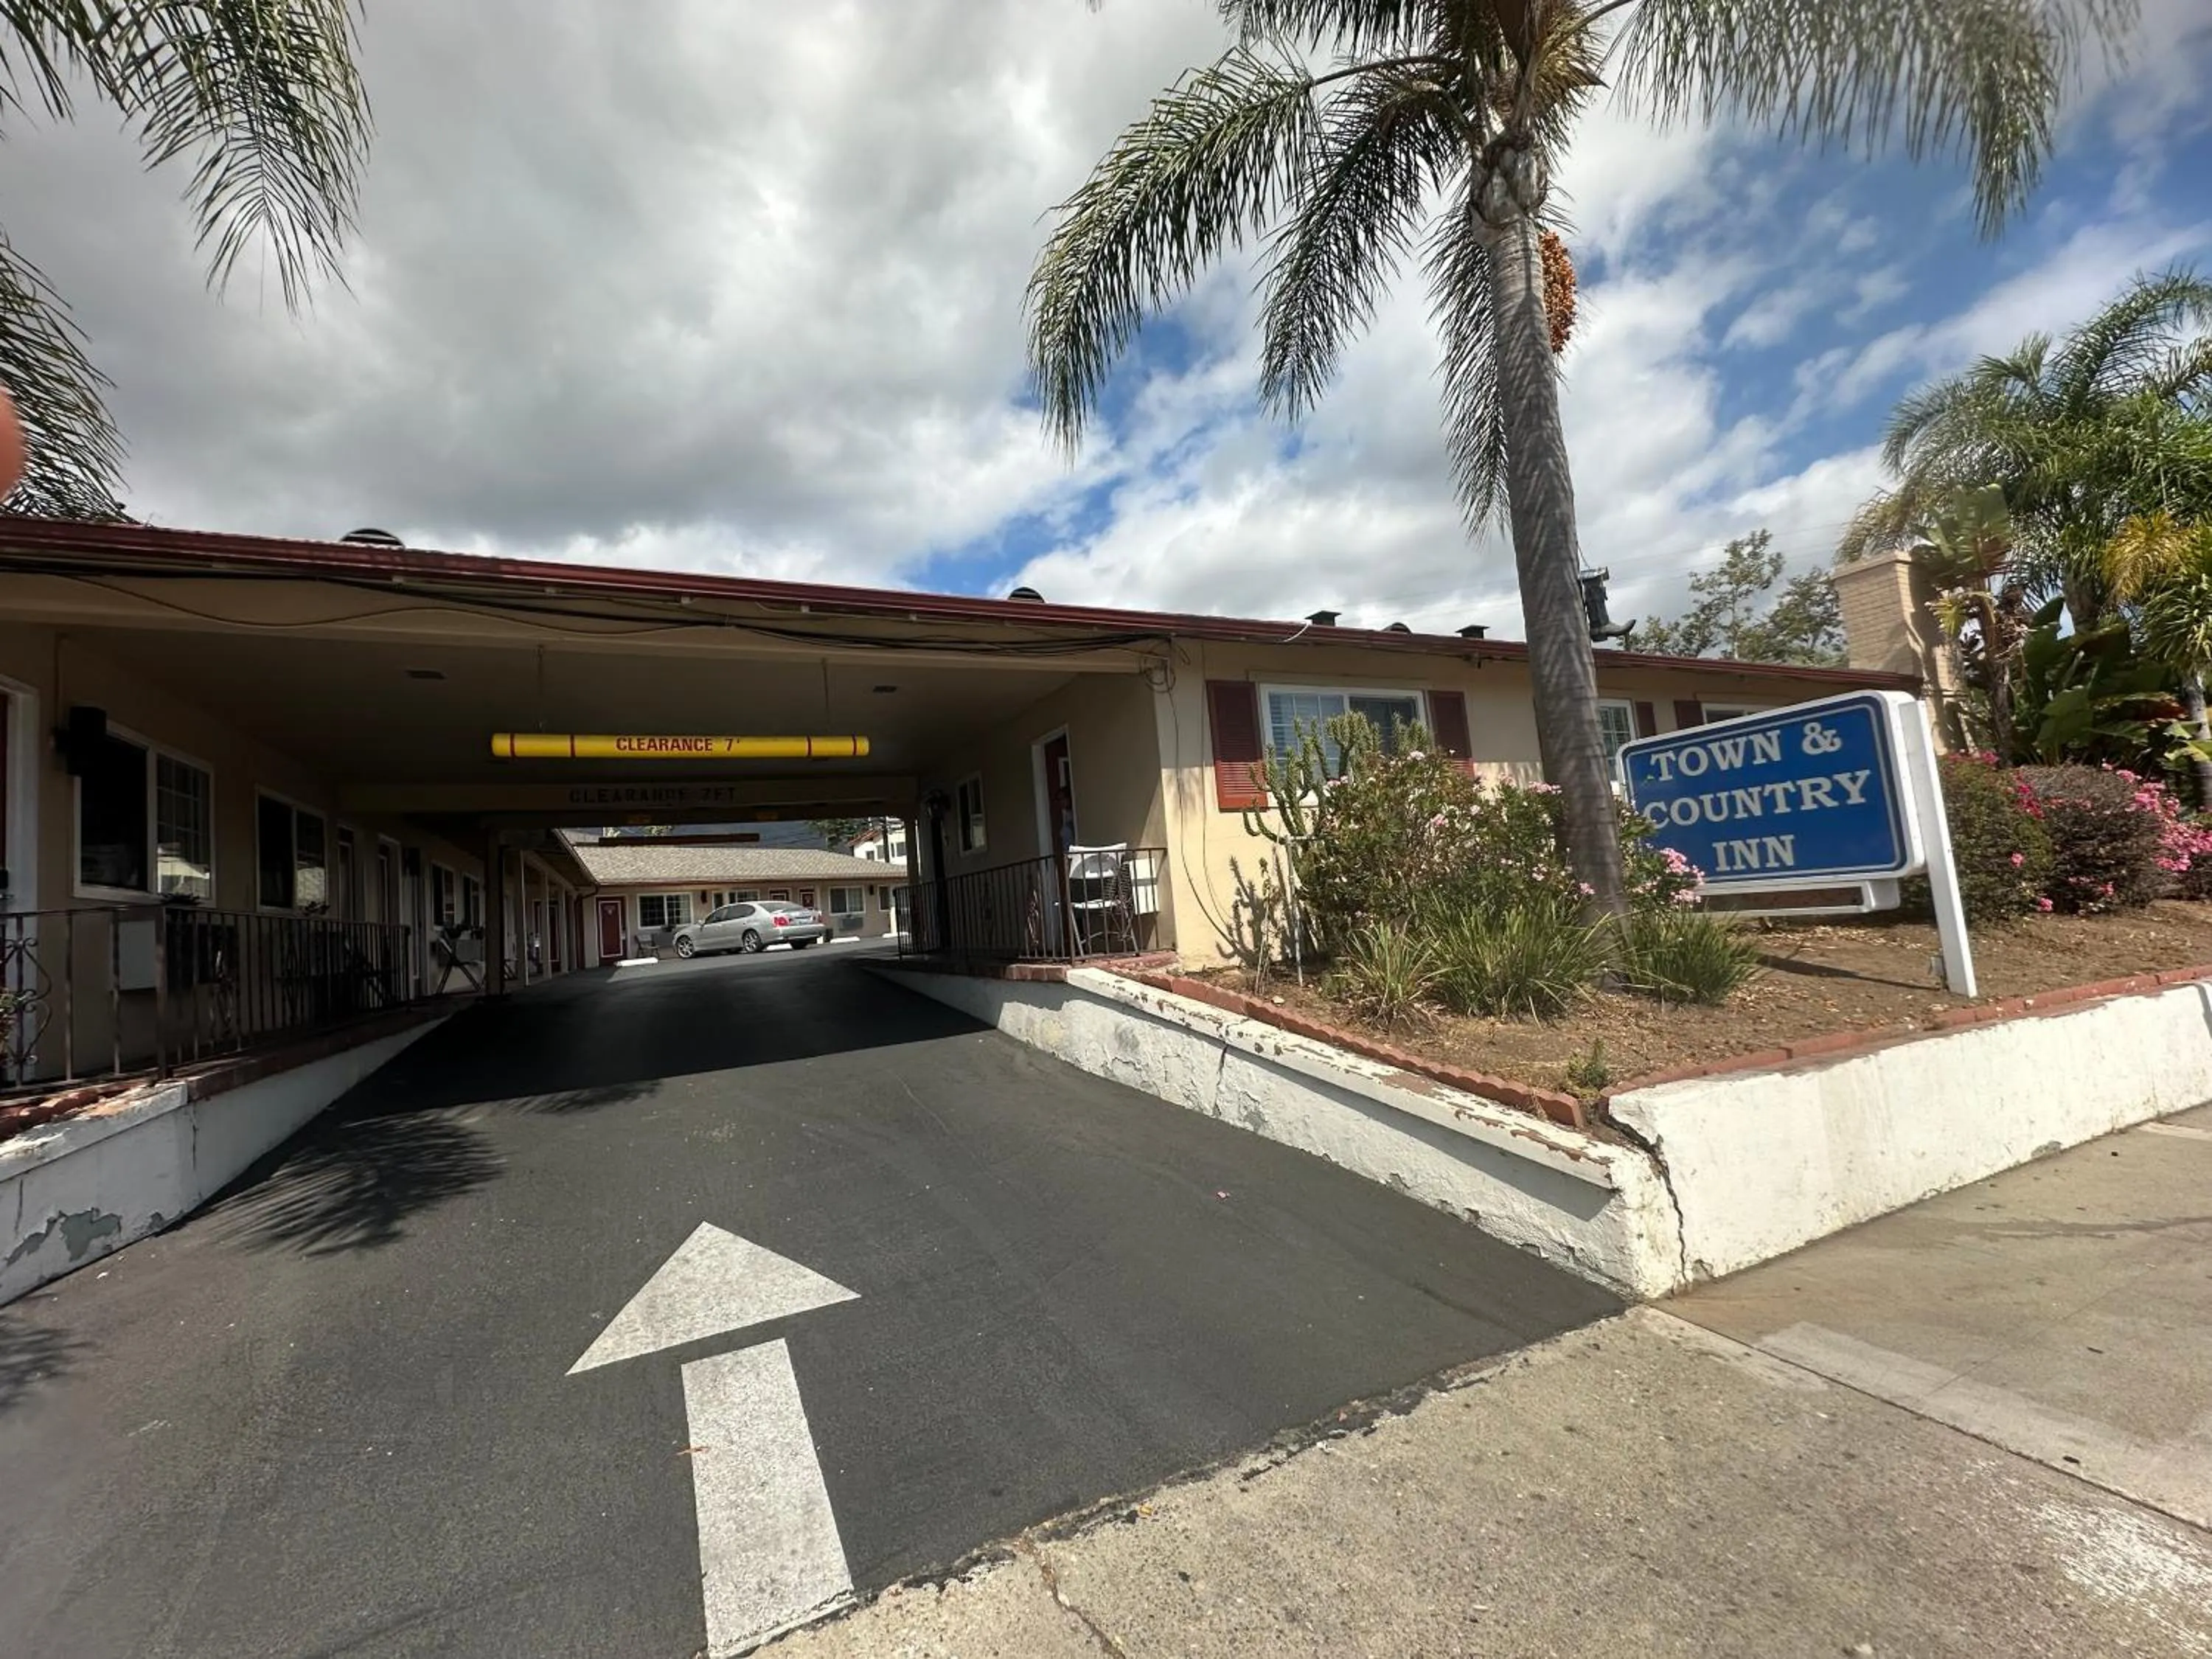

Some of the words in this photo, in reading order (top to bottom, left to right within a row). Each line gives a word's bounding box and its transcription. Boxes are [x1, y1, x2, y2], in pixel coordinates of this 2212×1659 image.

[616, 737, 713, 752] CLEARANCE
[724, 738, 740, 751] 7'
[1650, 729, 1782, 782] TOWN
[1801, 722, 1843, 756] &
[1642, 769, 1871, 830] COUNTRY
[1711, 834, 1796, 872] INN
